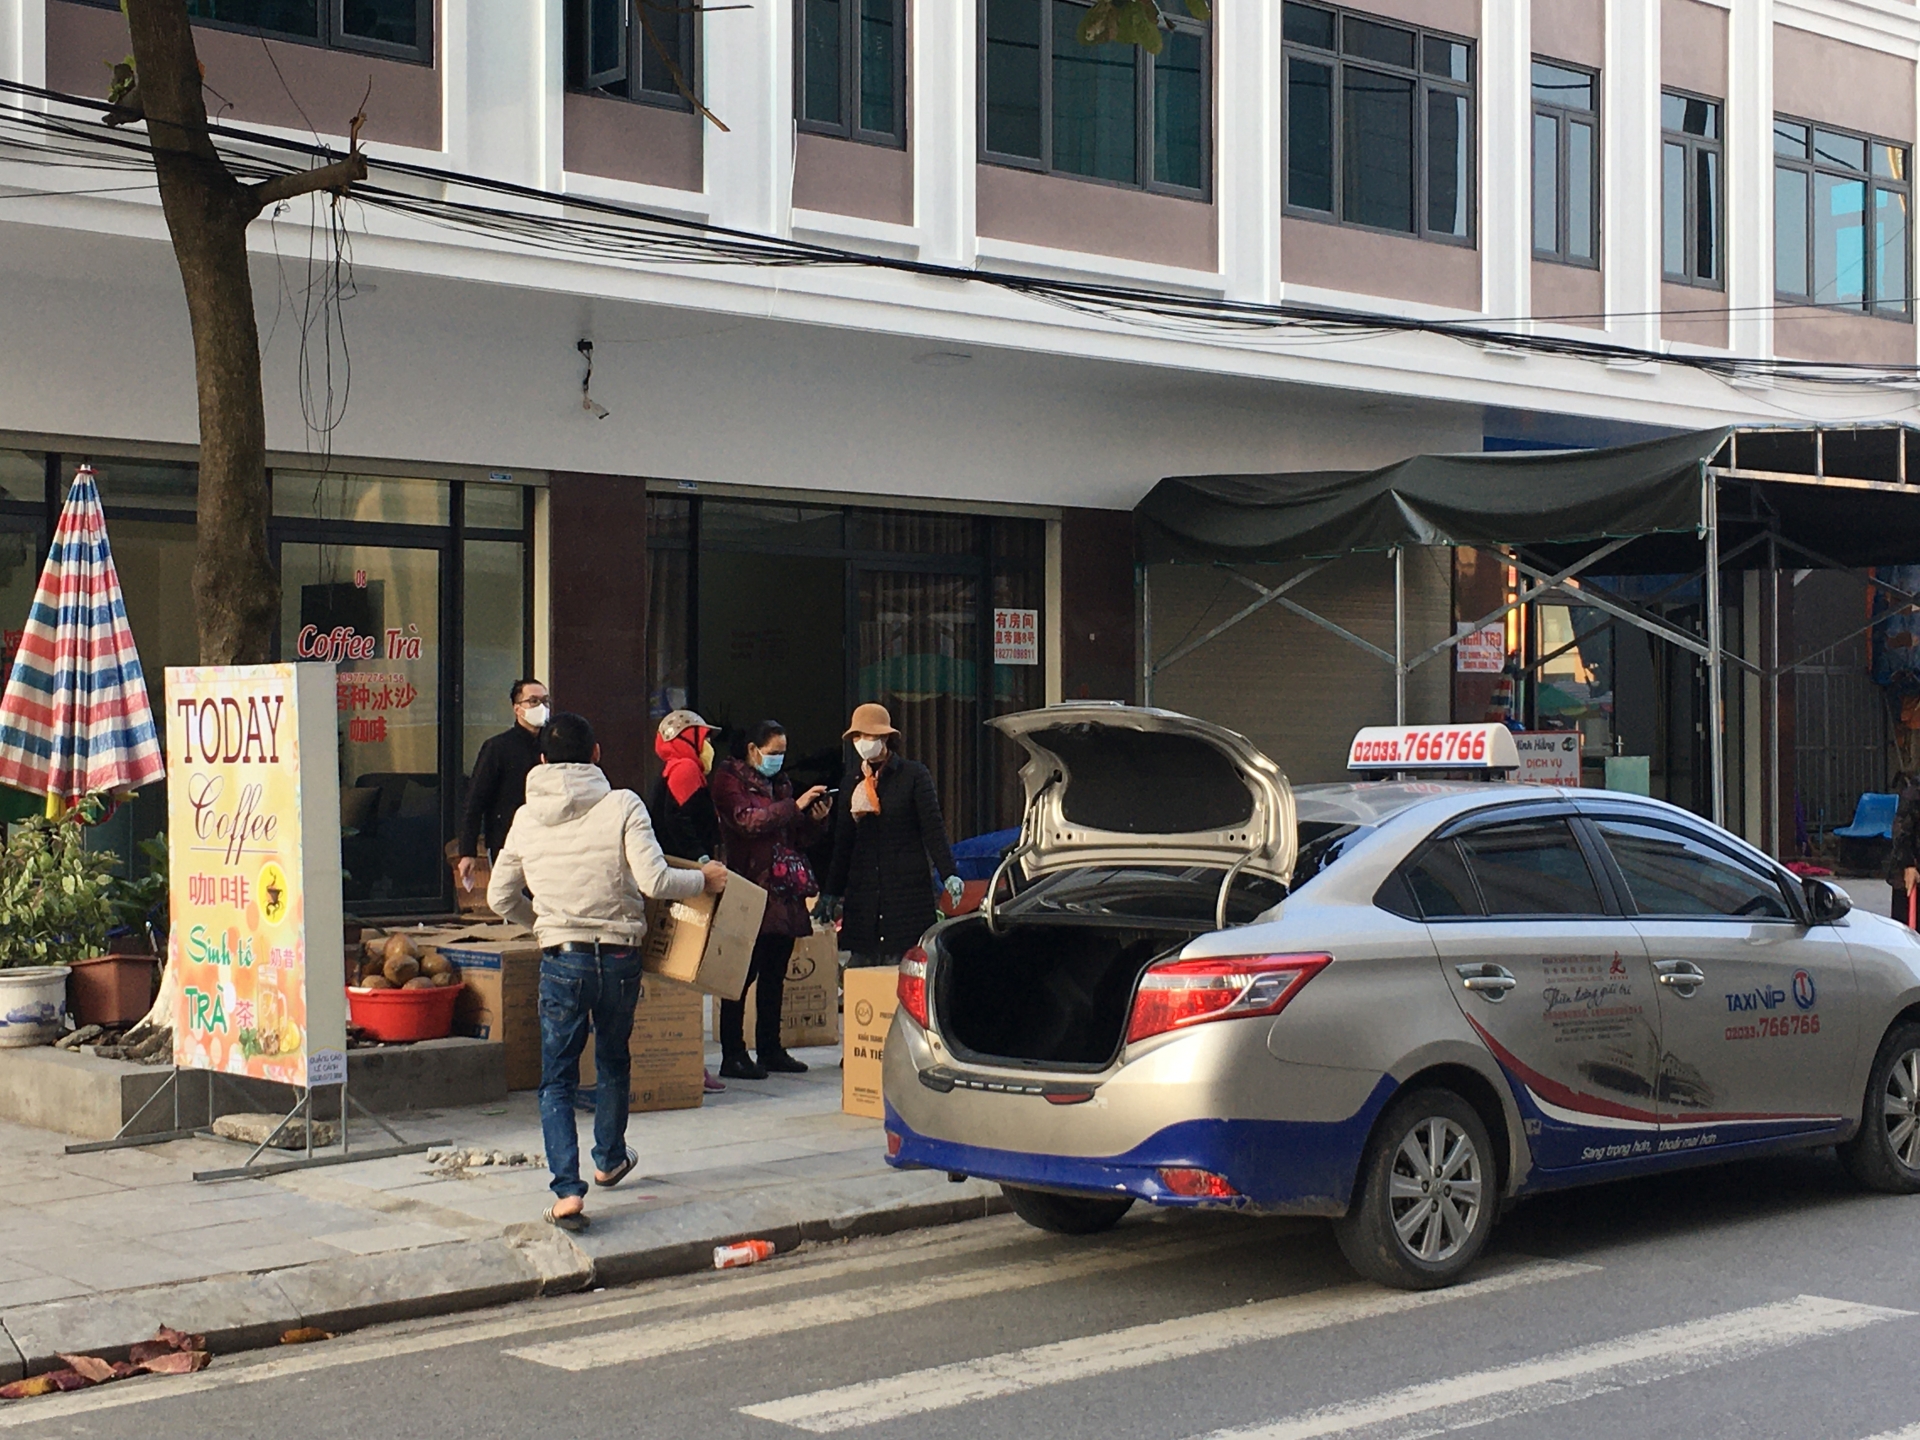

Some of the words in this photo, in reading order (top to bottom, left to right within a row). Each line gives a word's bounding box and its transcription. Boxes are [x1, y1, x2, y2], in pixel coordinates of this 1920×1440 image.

[355, 570, 367, 588] 08
[996, 612, 1034, 629] 有房间
[297, 624, 376, 662] Coffee
[385, 623, 422, 661] Trà
[177, 695, 284, 764] TODAY
[349, 716, 387, 742] 咖啡
[188, 773, 277, 865] Coffee
[189, 873, 250, 909] 咖啡
[188, 926, 232, 966] Sinh
[238, 938, 254, 966] tố
[269, 947, 295, 969] 奶昔
[185, 985, 227, 1033] TRÀ
[235, 1001, 254, 1027] 茶
[1725, 993, 1757, 1011] TAXI
